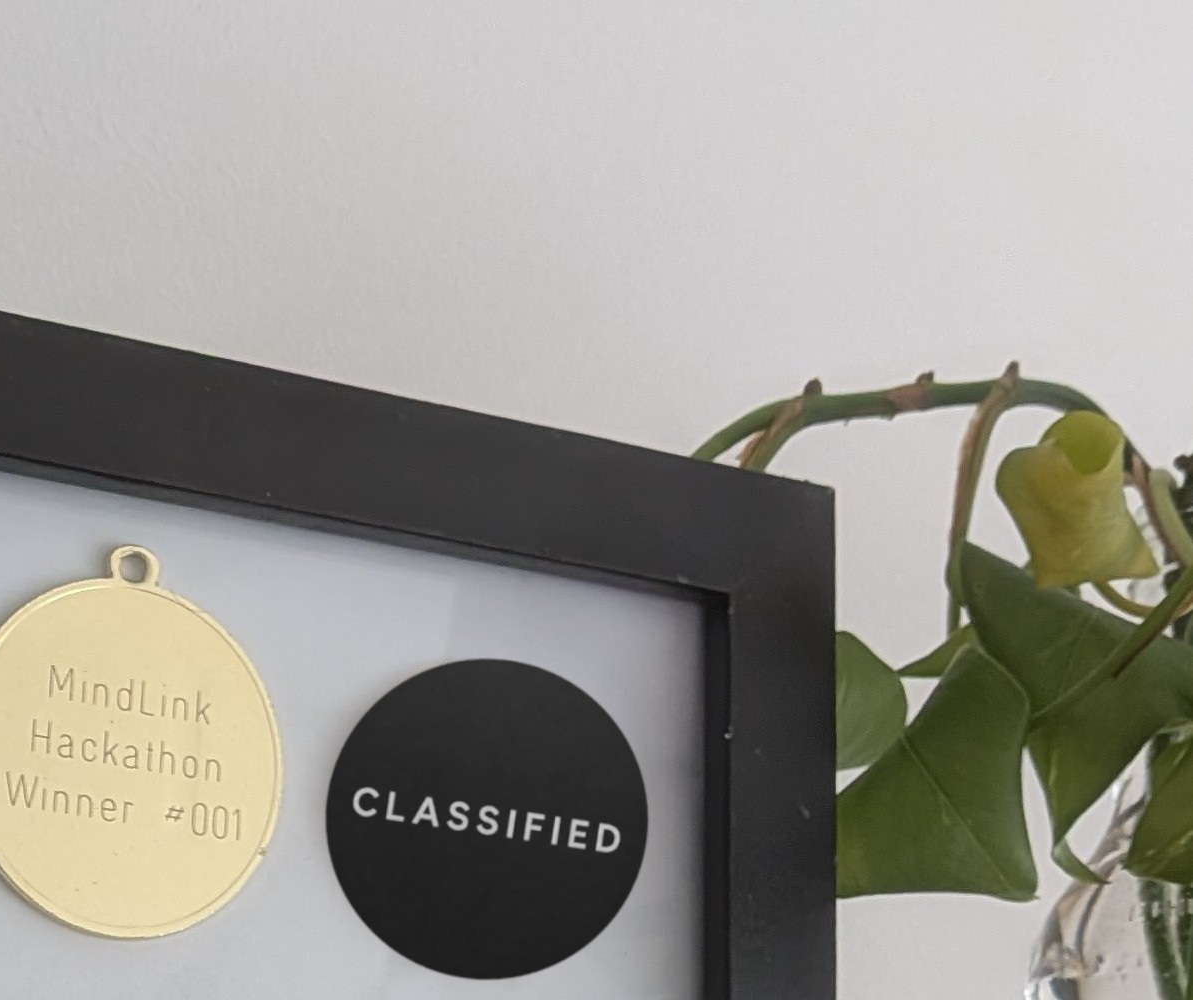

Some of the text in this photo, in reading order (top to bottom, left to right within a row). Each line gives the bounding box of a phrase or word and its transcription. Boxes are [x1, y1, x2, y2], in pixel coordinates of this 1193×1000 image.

[47, 664, 213, 726] MindLink
[29, 718, 223, 783] Hackathon
[5, 770, 243, 842] Winner #001
[352, 787, 621, 853] CLASSIFIED
